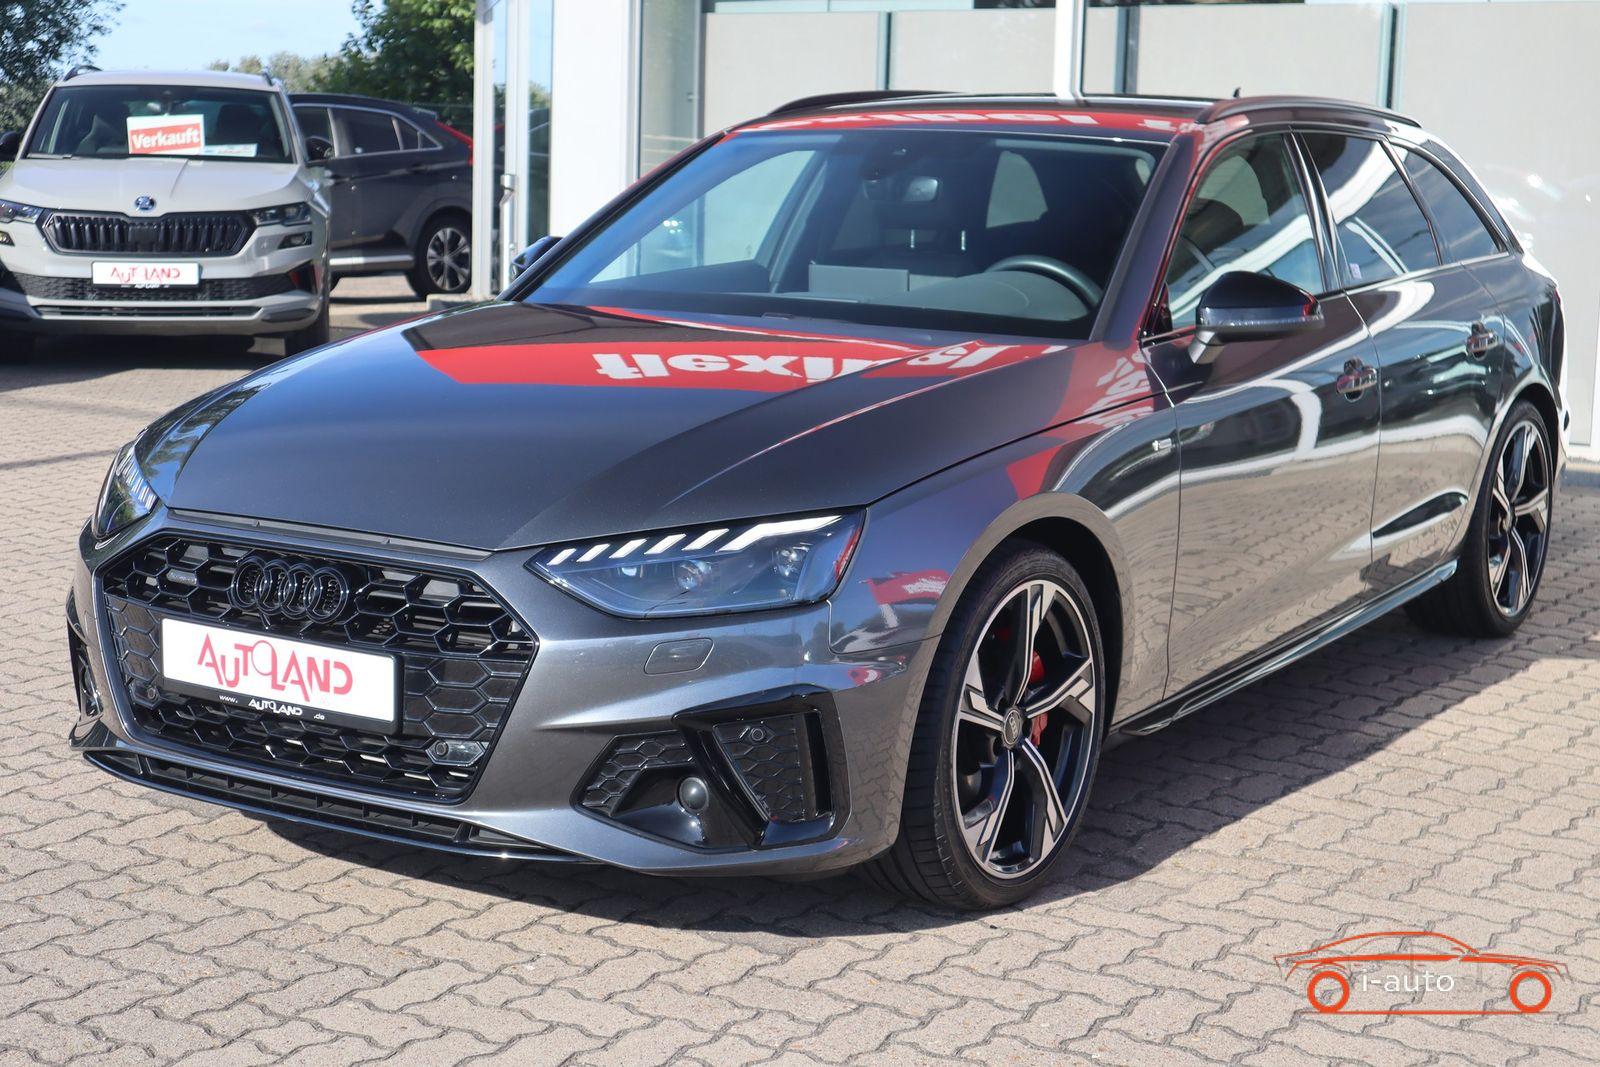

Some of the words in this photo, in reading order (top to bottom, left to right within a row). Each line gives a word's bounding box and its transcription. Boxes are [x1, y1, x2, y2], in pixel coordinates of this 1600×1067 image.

[132, 128, 200, 149] Verkauft
[110, 267, 181, 284] AUTLAND
[197, 633, 353, 702] AUTOLAND
[249, 698, 303, 716] AUTOLAND
